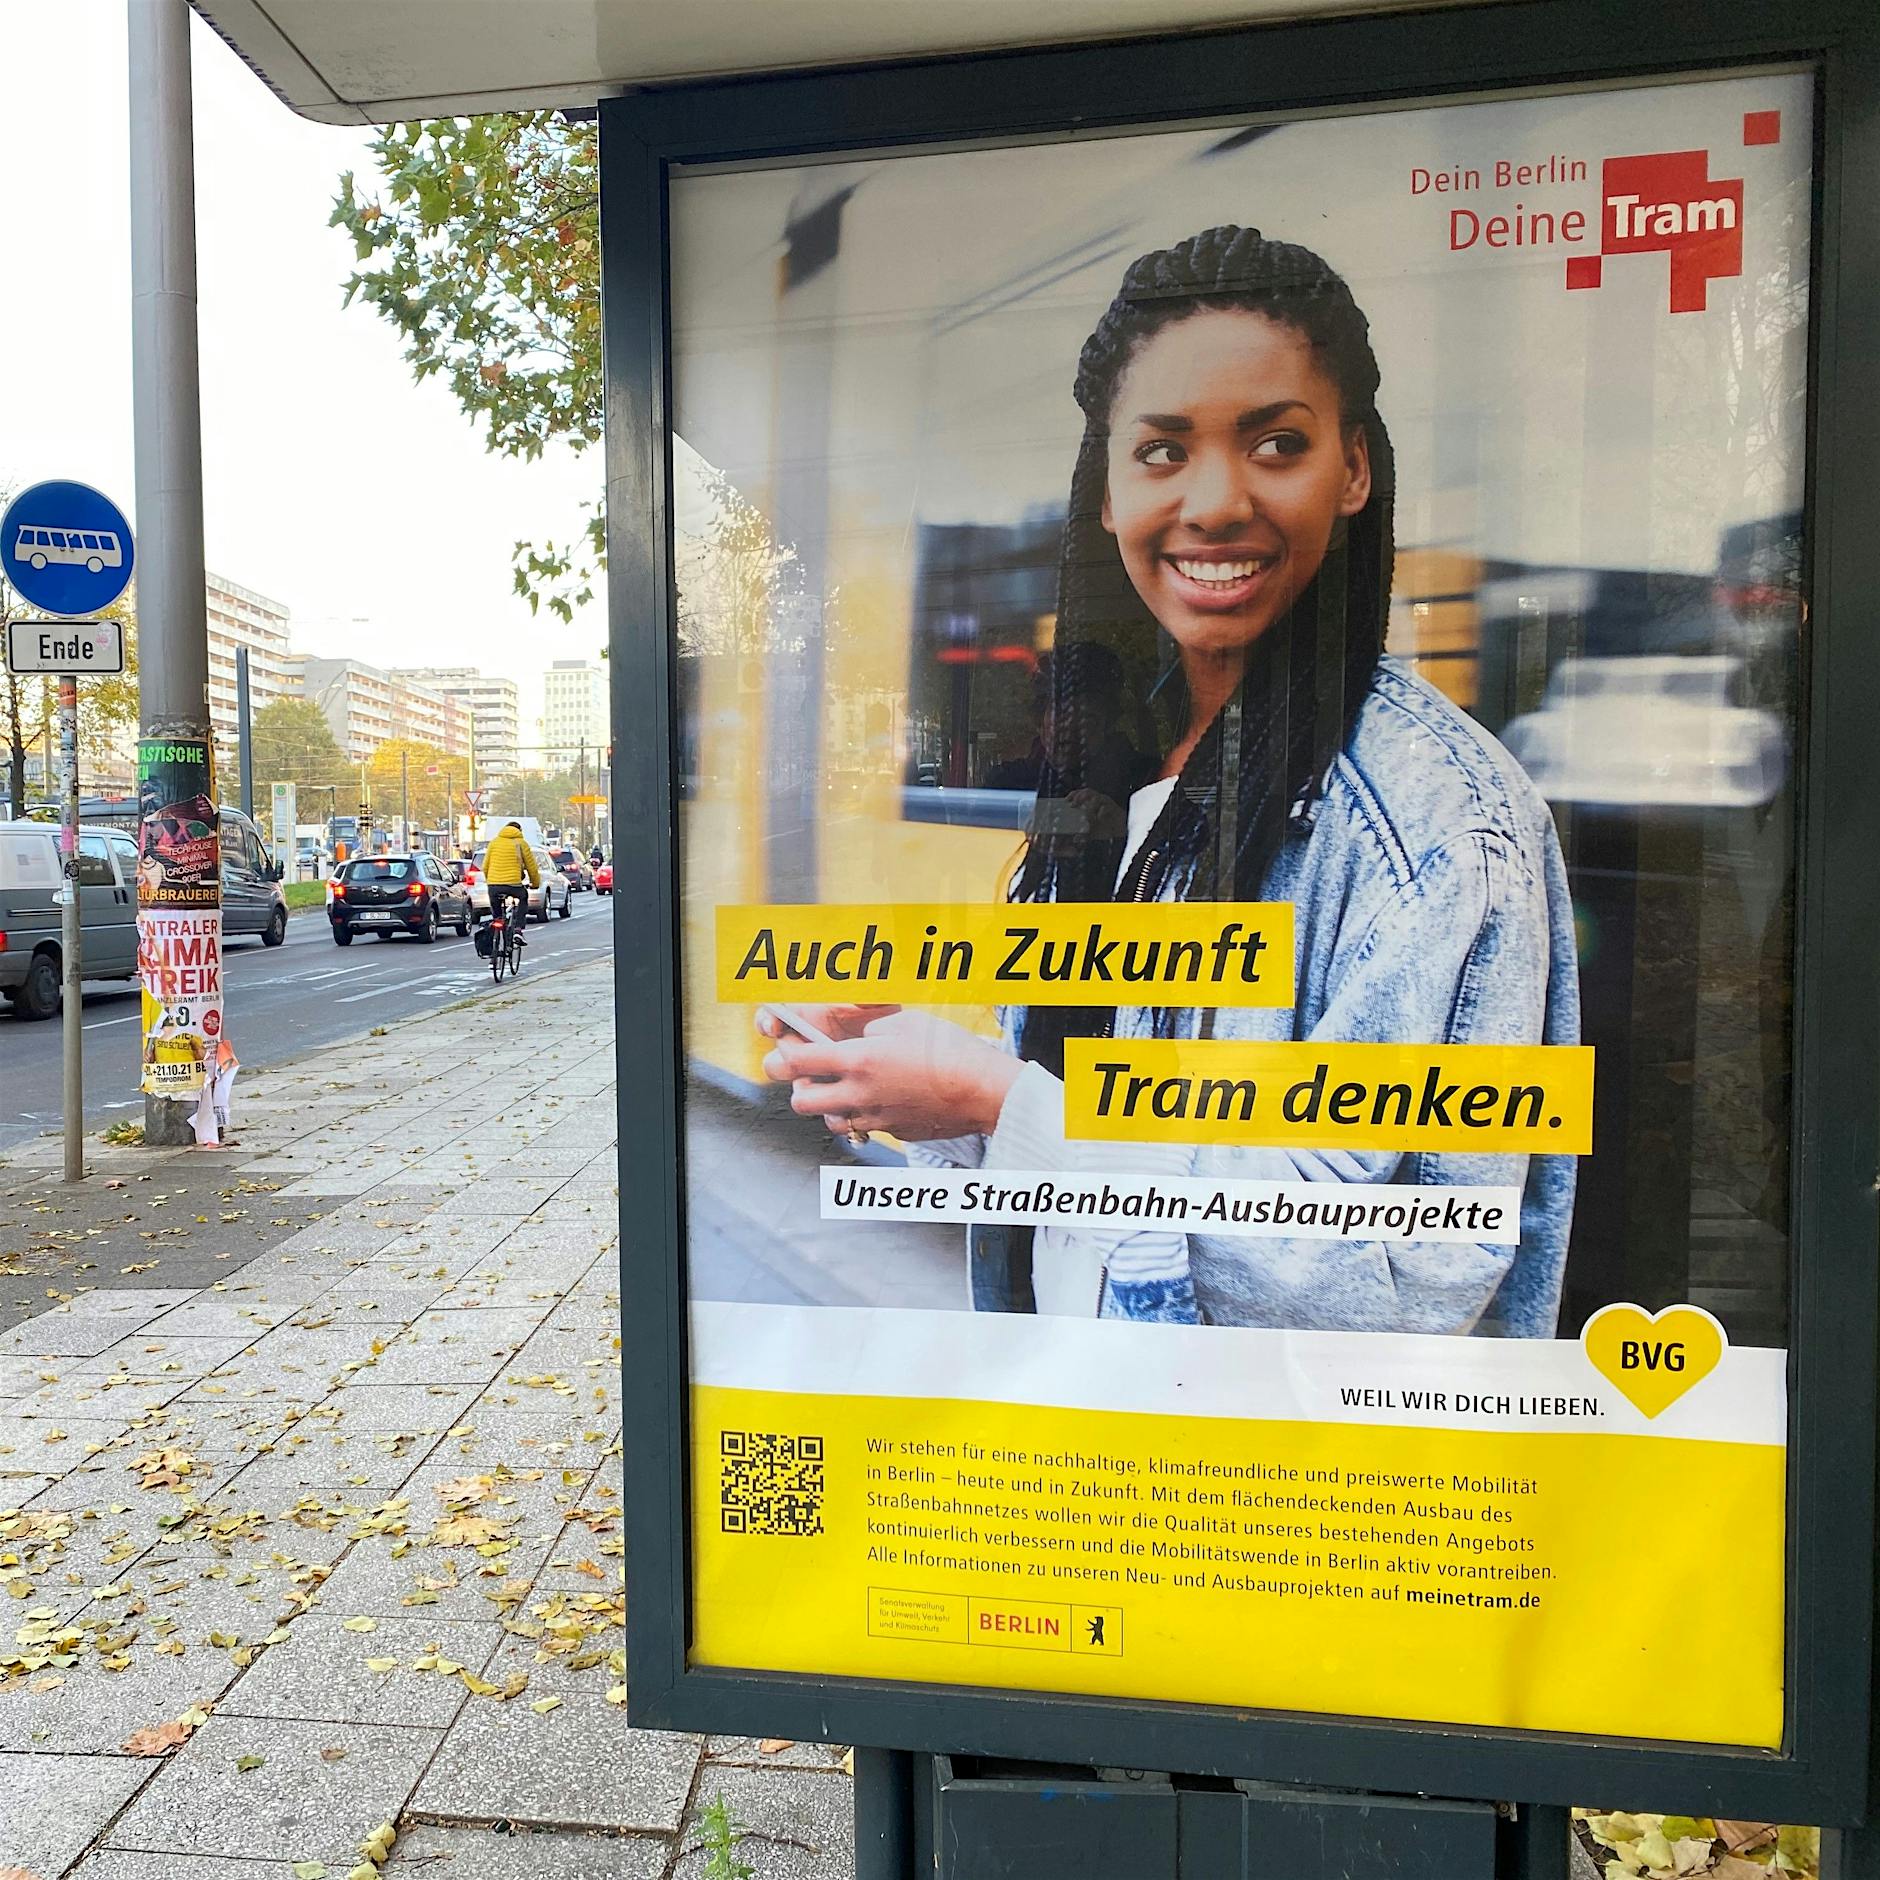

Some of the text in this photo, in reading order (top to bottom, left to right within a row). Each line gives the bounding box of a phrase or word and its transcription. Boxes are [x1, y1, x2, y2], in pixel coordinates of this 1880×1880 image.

[1412, 155, 1586, 194] Dein Berlin
[1451, 193, 1736, 250] Deine Tram
[39, 634, 94, 660] Ende
[167, 861, 212, 877] CROSSOVER
[735, 923, 1267, 982] Auch in Zukunft
[138, 968, 219, 994] TREIK
[1094, 1063, 1561, 1128] Tram denken.
[835, 1180, 1502, 1236] Unsere Straßenbahn-Ausbauprojekte
[1622, 1342, 1684, 1371] BVG
[1341, 1388, 1604, 1415] WEIL WIR DICH LIEBEN.
[867, 1438, 1536, 1493] Wir stehen für eine nachhaltige, klimafreundliche und preiswerte Mobilität
[868, 1465, 881, 1480] in
[889, 1466, 934, 1483] Berlin
[958, 1470, 1004, 1489] heute
[1012, 1478, 1041, 1493] und
[1050, 1480, 1064, 1495] in
[1072, 1481, 1143, 1500] Zukunft.
[1153, 1487, 1179, 1502] Mit
[1188, 1488, 1223, 1504] dem
[1233, 1490, 1395, 1514] flächendeckenden
[1404, 1501, 1472, 1520] Ausbau
[1482, 1505, 1511, 1522] des
[868, 1492, 1533, 1554] Straßenbahnnetzes wollen wir die Qualität unseres bestehenden Angebots
[868, 1518, 1557, 1580] kontinuierlich verbessern und die Mobilitätswende in Berlin aktiv vorantreiben.
[868, 1546, 1540, 1608] Alle Informationen zu unseren Neu- und Ausbauprojekten auf meinetram.de
[981, 1613, 1059, 1635] BERLIN
